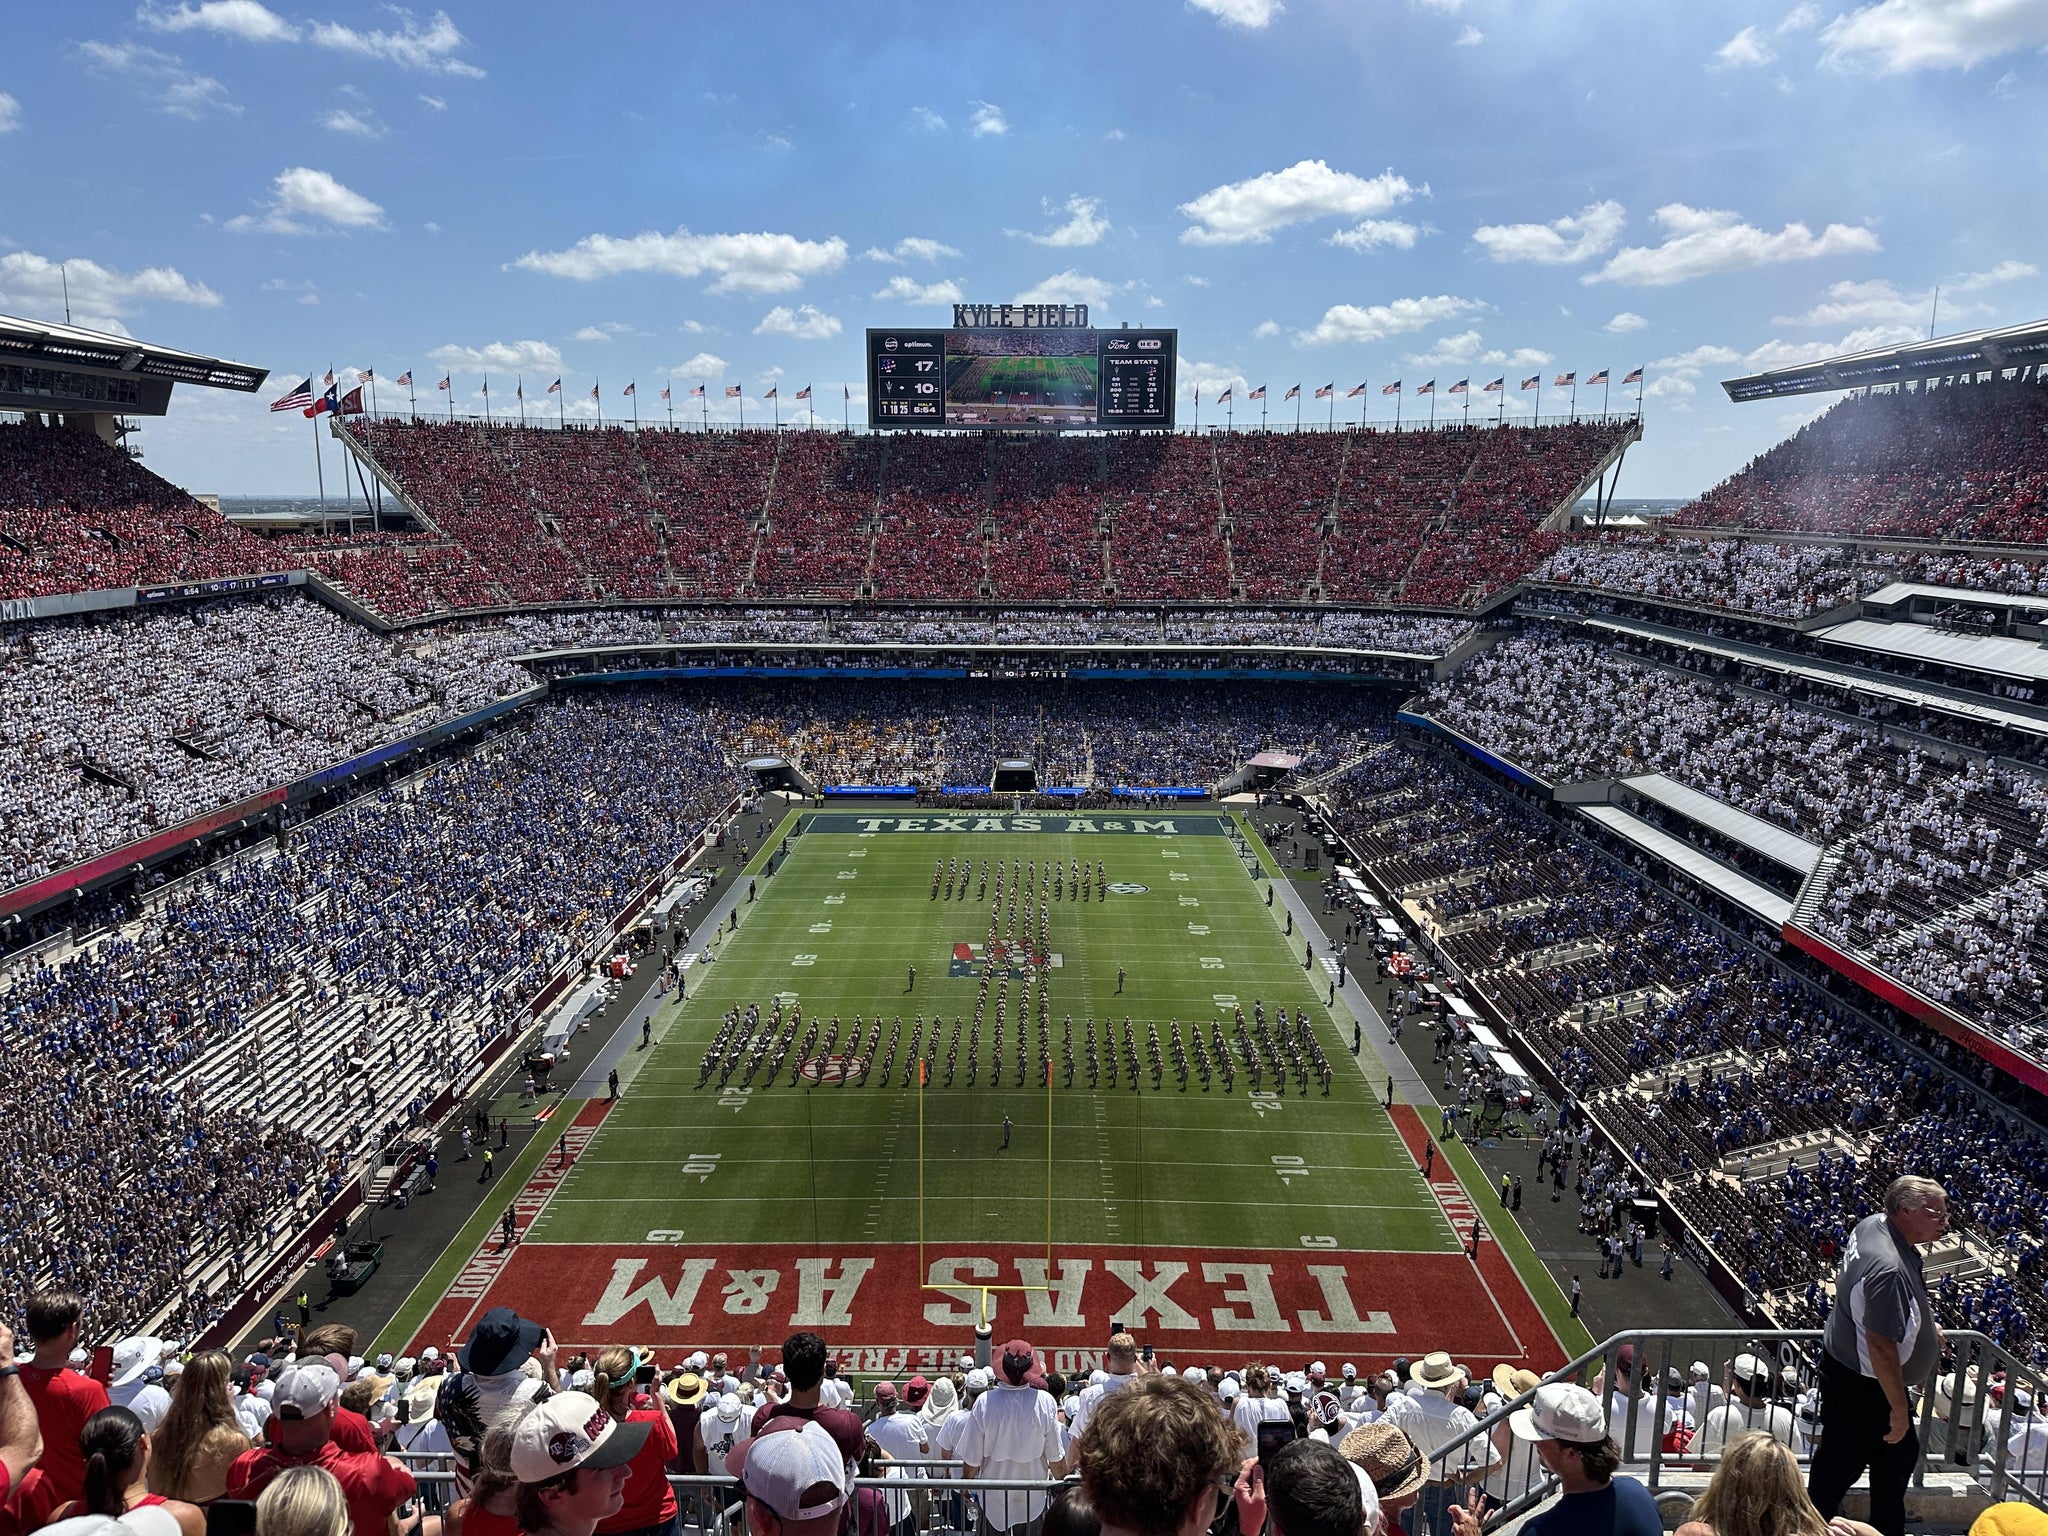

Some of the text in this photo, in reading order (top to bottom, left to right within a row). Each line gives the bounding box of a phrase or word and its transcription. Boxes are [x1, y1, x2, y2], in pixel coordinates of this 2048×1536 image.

[953, 304, 1089, 328] KYLE FIELD
[1108, 339, 1130, 350] Ford
[915, 361, 934, 371] 17
[914, 383, 934, 394] 10
[890, 405, 898, 414] 10
[900, 405, 908, 414] 25
[210, 583, 219, 592] 10
[857, 818, 1178, 833] TEXAS A&M
[824, 895, 846, 904] 30
[1178, 897, 1200, 906] 30
[808, 922, 832, 932] 40
[1188, 925, 1211, 936] 40
[792, 954, 818, 966] 50
[1200, 957, 1225, 969] 50
[1212, 994, 1241, 1009] 40
[452, 1060, 485, 1099] optimum.
[717, 1087, 753, 1106] 20
[1248, 1090, 1283, 1110] 20
[681, 1153, 722, 1174] 10
[1270, 1155, 1310, 1176] 10
[445, 1248, 512, 1299] HOME
[514, 1187, 554, 1216] THE
[550, 1125, 597, 1155] MAN
[1683, 1228, 1710, 1267] Govee
[262, 1237, 311, 1294] Google Gemini
[580, 1256, 1397, 1334] TEXAS A&M
[916, 1349, 968, 1372] HE
